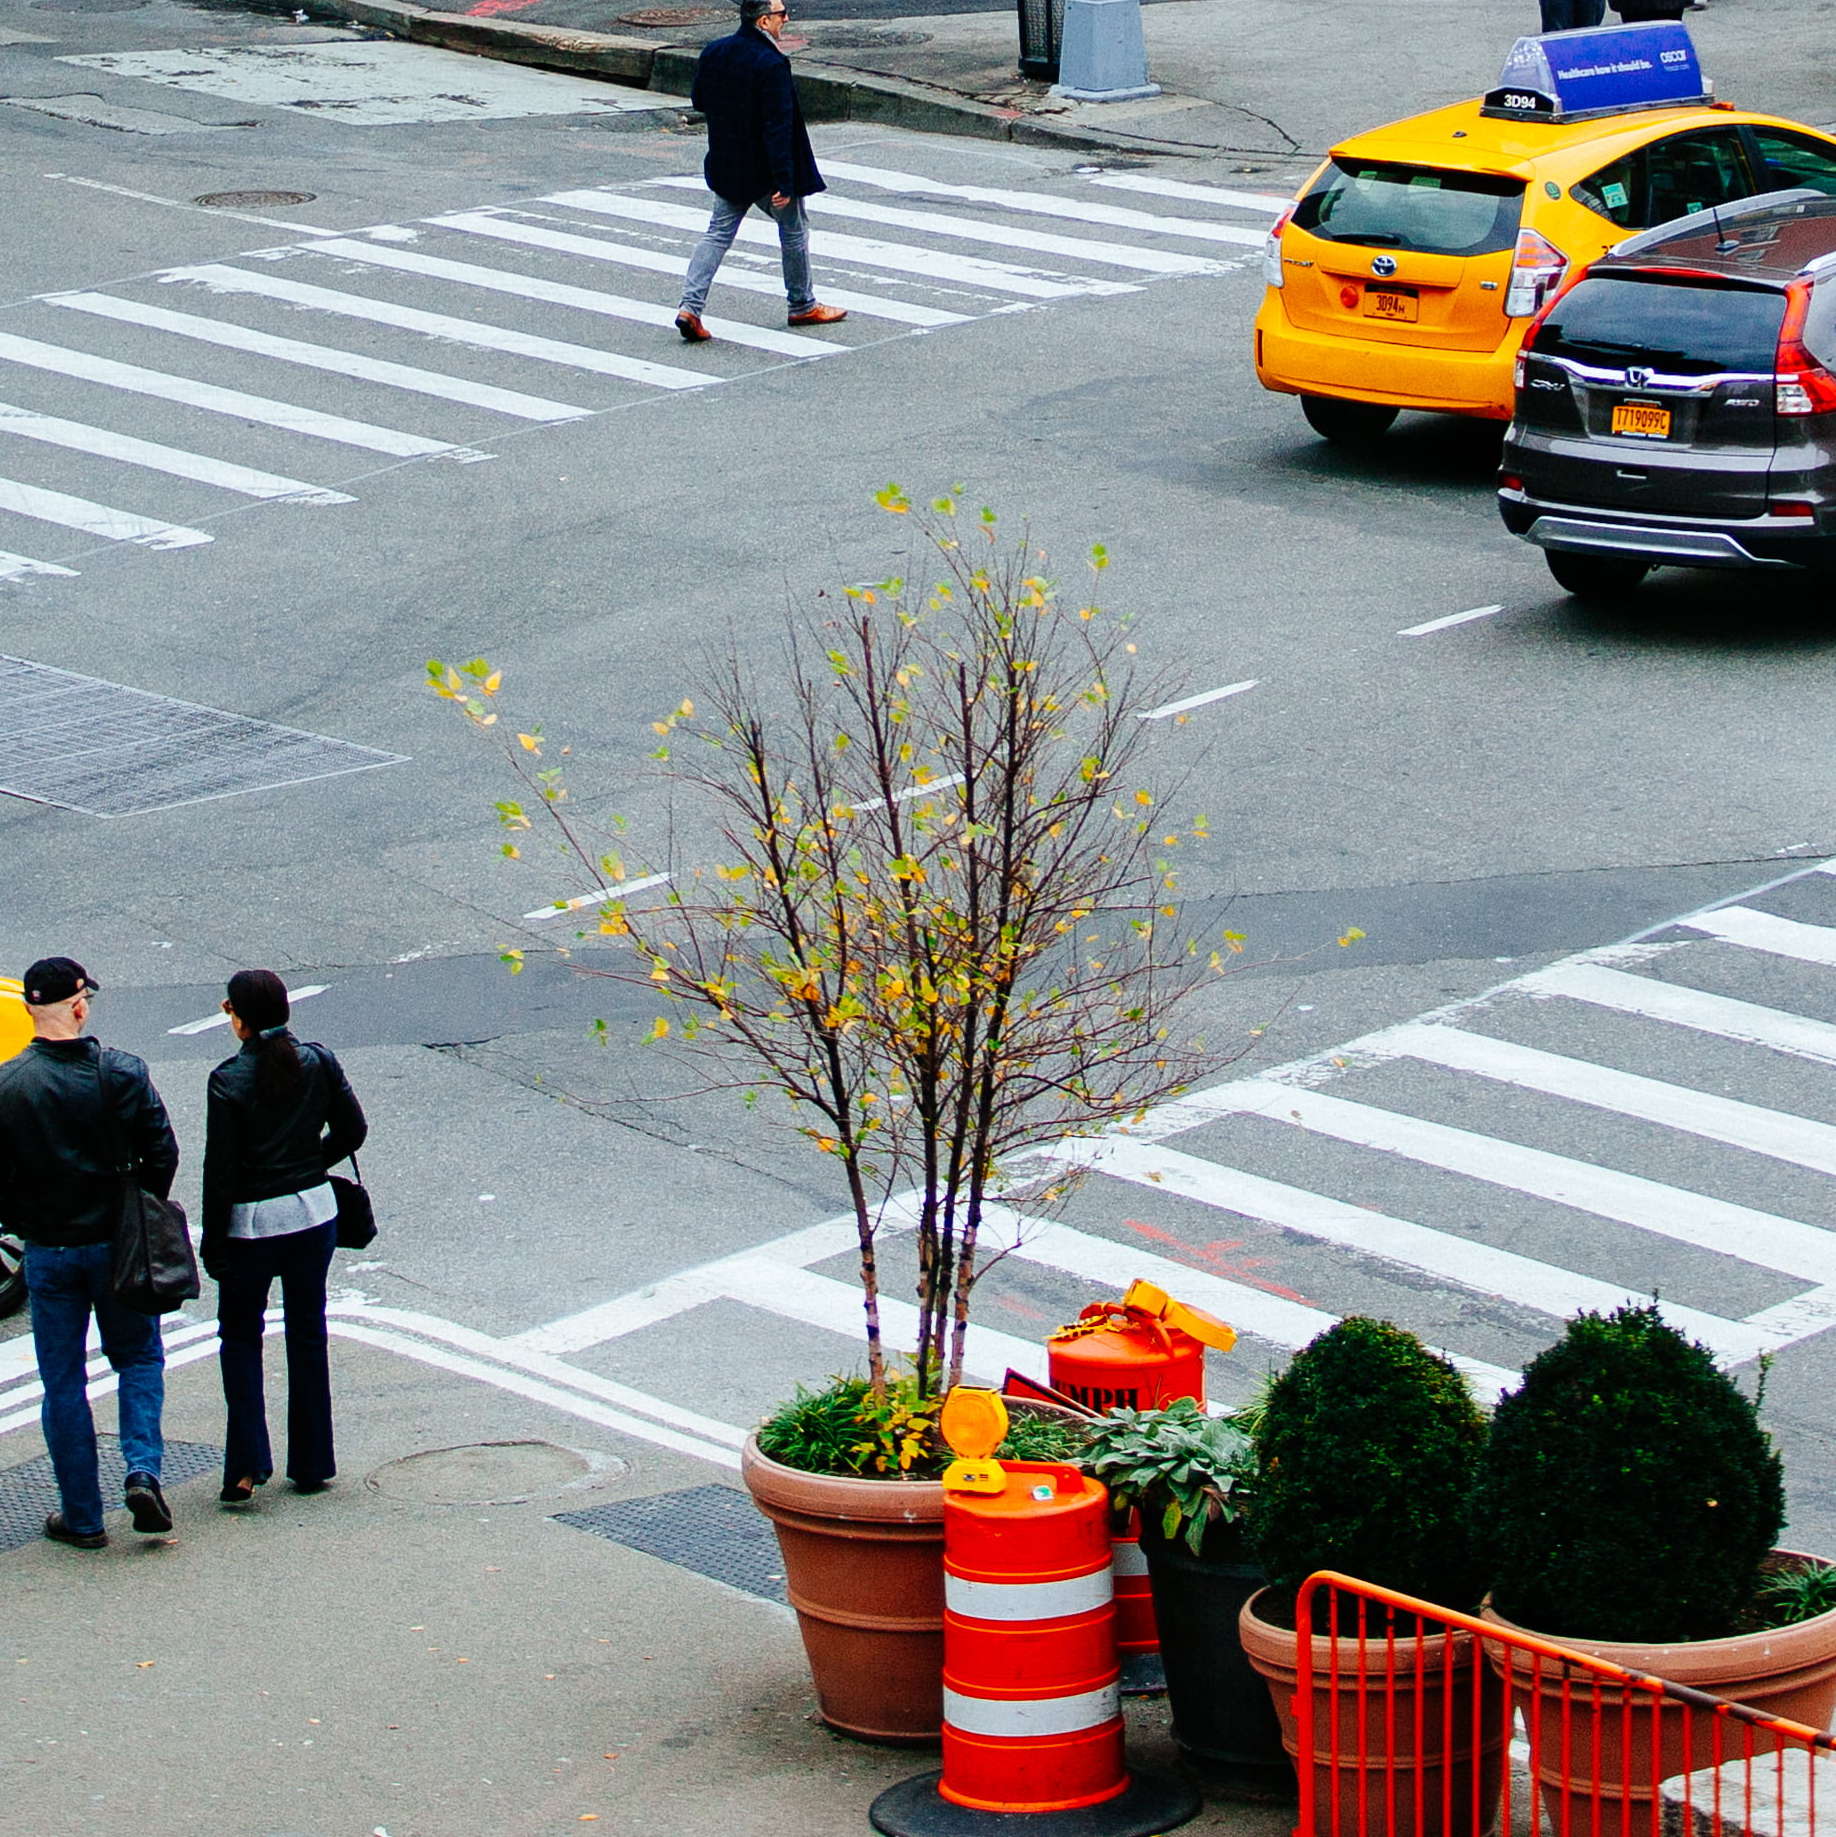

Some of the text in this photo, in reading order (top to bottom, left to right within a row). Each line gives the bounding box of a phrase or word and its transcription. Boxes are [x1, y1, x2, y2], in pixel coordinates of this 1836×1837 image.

[1660, 49, 1687, 63] oscar
[1557, 69, 1595, 81] Healthcare
[1595, 64, 1611, 75] how
[1617, 60, 1639, 72] should
[1504, 94, 1536, 109] 3D94
[1616, 407, 1667, 431] T719099C
